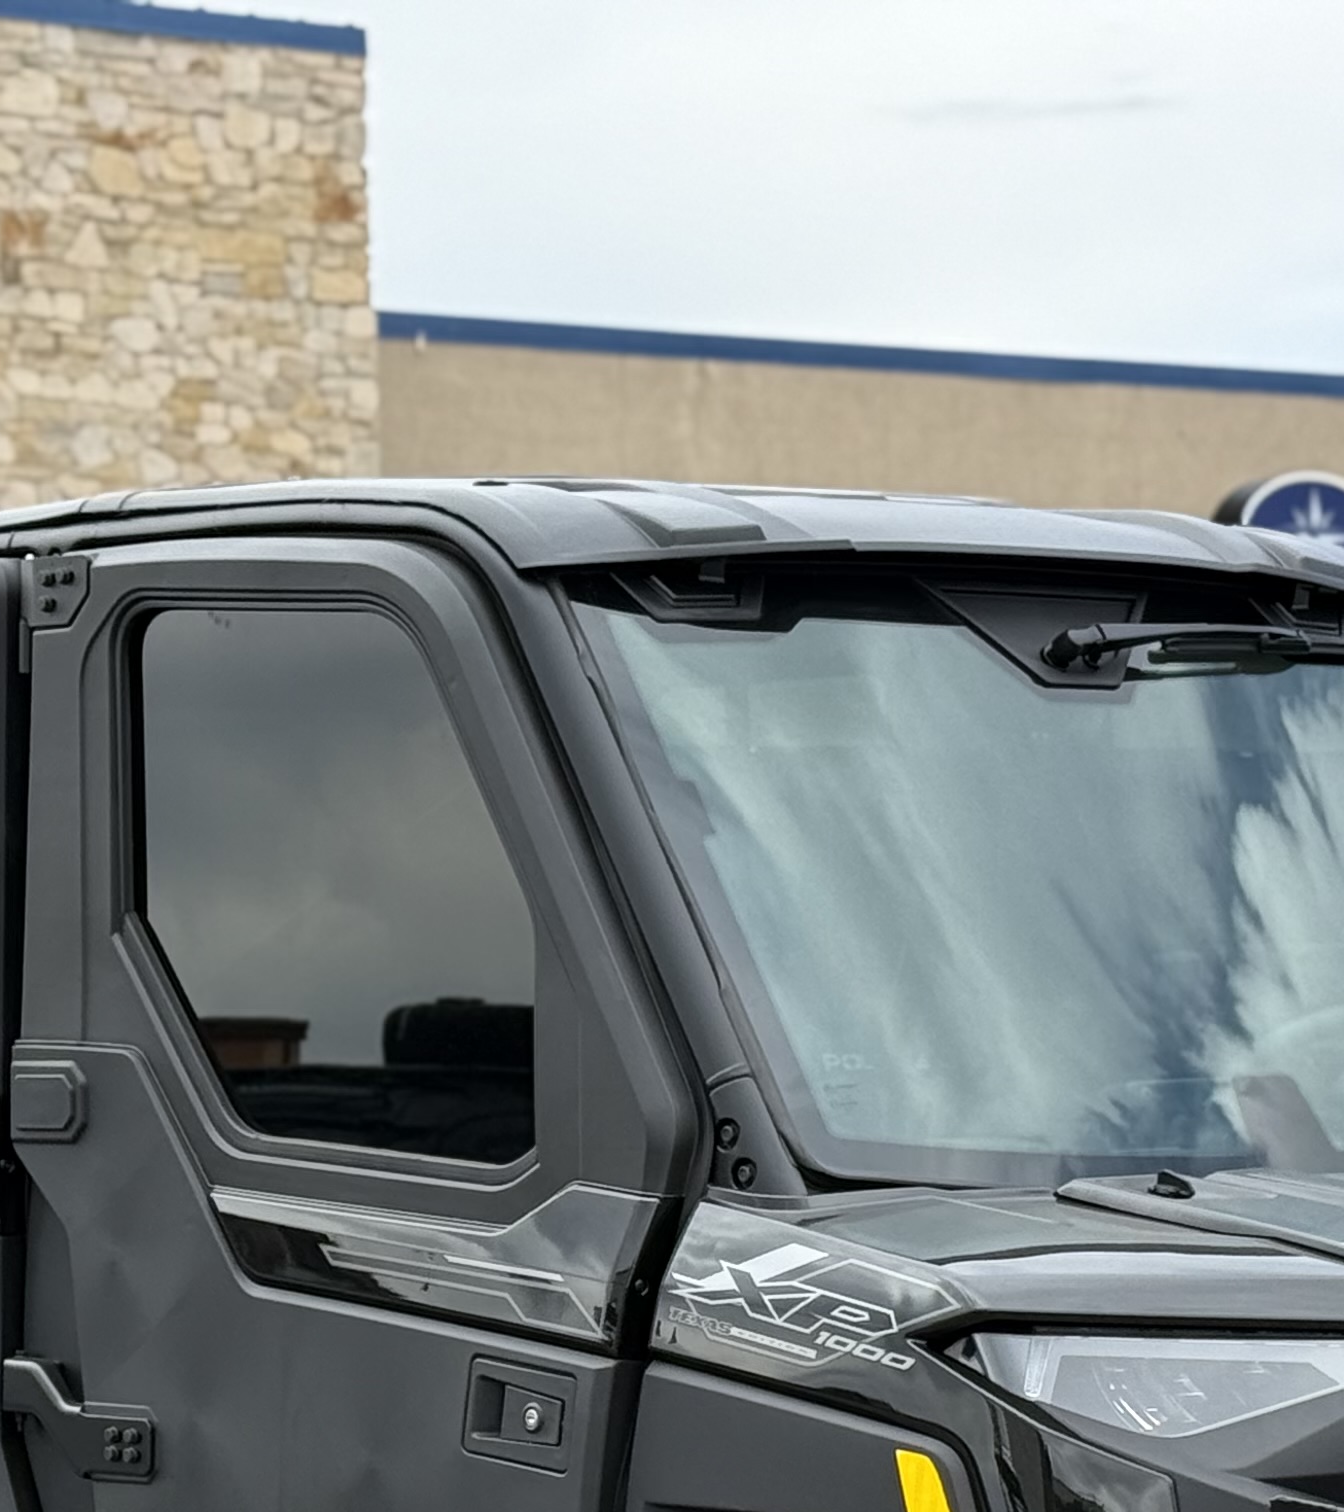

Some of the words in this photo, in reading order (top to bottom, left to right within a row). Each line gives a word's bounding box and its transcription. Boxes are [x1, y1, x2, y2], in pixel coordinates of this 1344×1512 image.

[668, 1243, 900, 1338] XP
[669, 1306, 734, 1336] TEXAS
[814, 1331, 917, 1371] 1000
